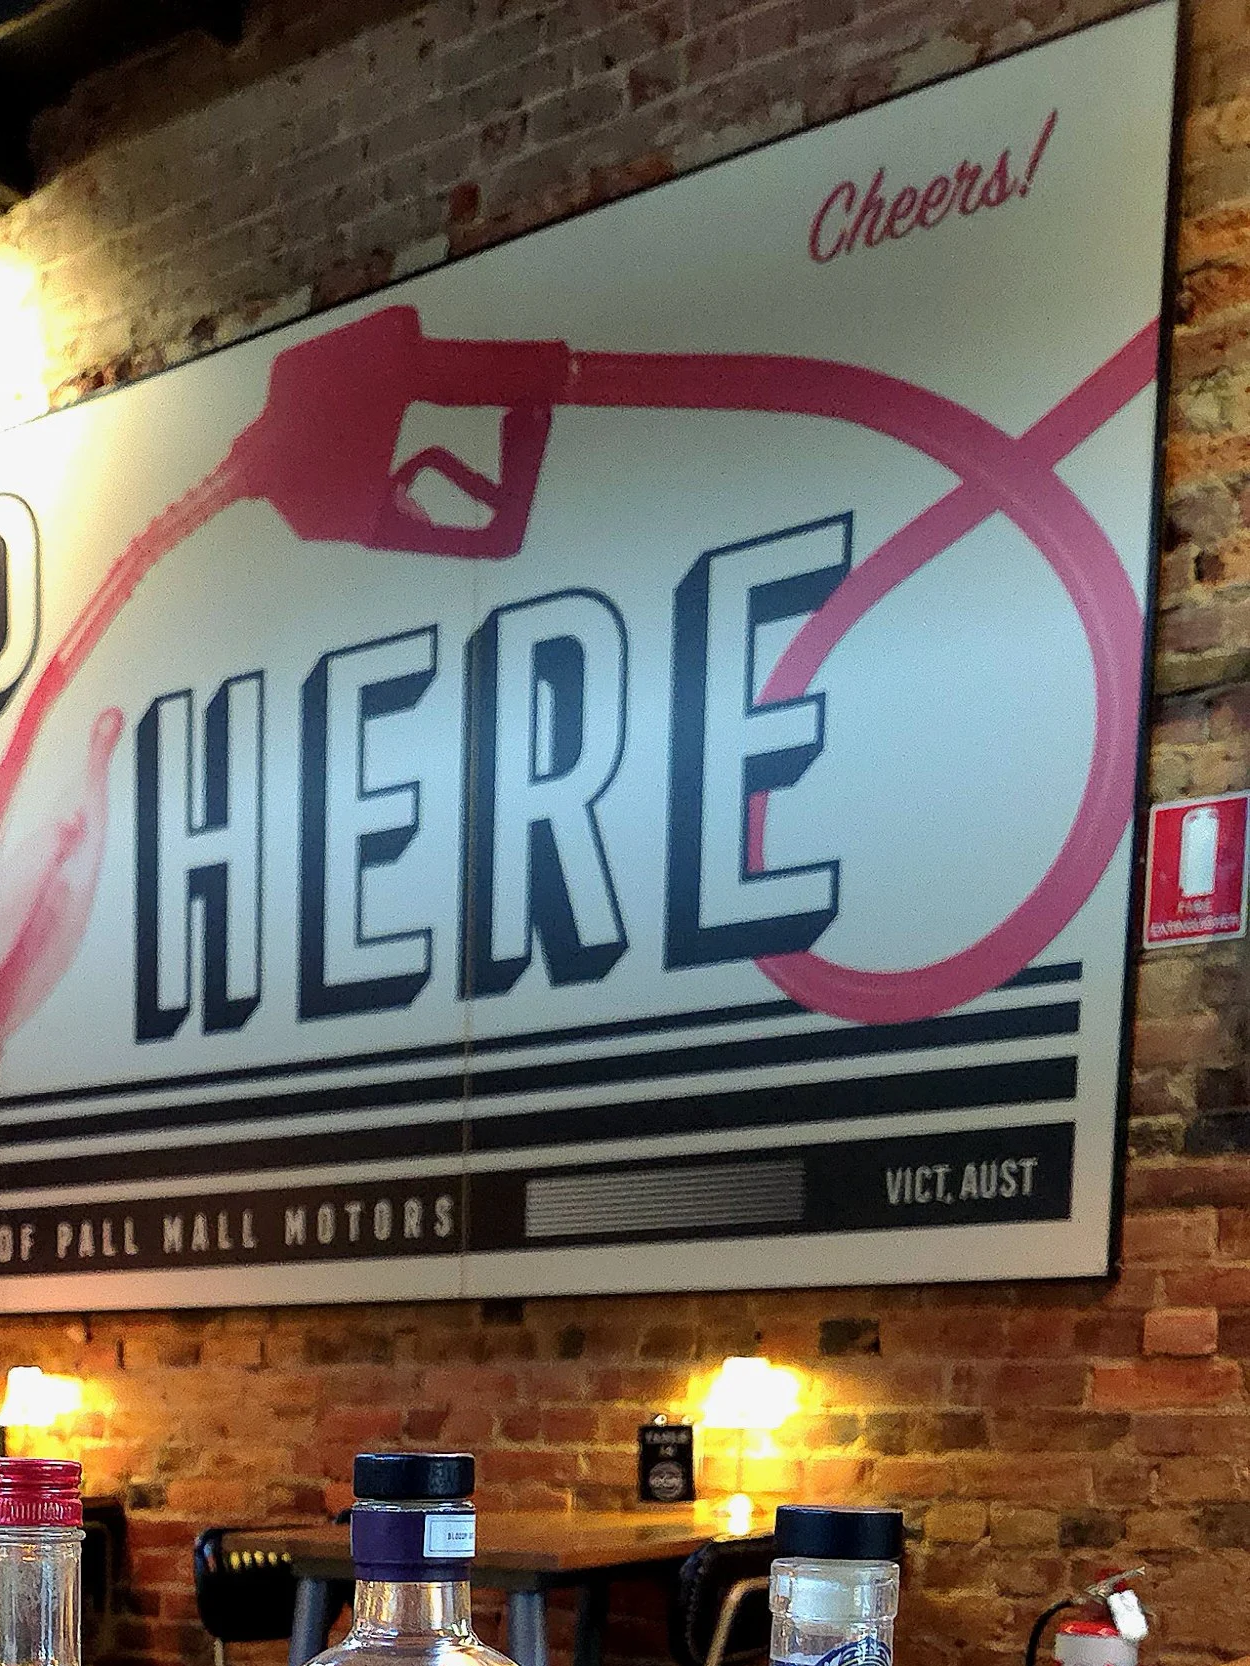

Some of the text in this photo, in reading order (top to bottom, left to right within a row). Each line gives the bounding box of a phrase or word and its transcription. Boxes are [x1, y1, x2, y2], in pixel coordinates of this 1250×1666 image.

[808, 108, 1059, 263] Cheers!
[134, 510, 854, 1046] HERE
[56, 1216, 140, 1259] PALL
[162, 1208, 258, 1255] MALL
[284, 1194, 456, 1247] MOTORS
[959, 1157, 1038, 1202] AUST
